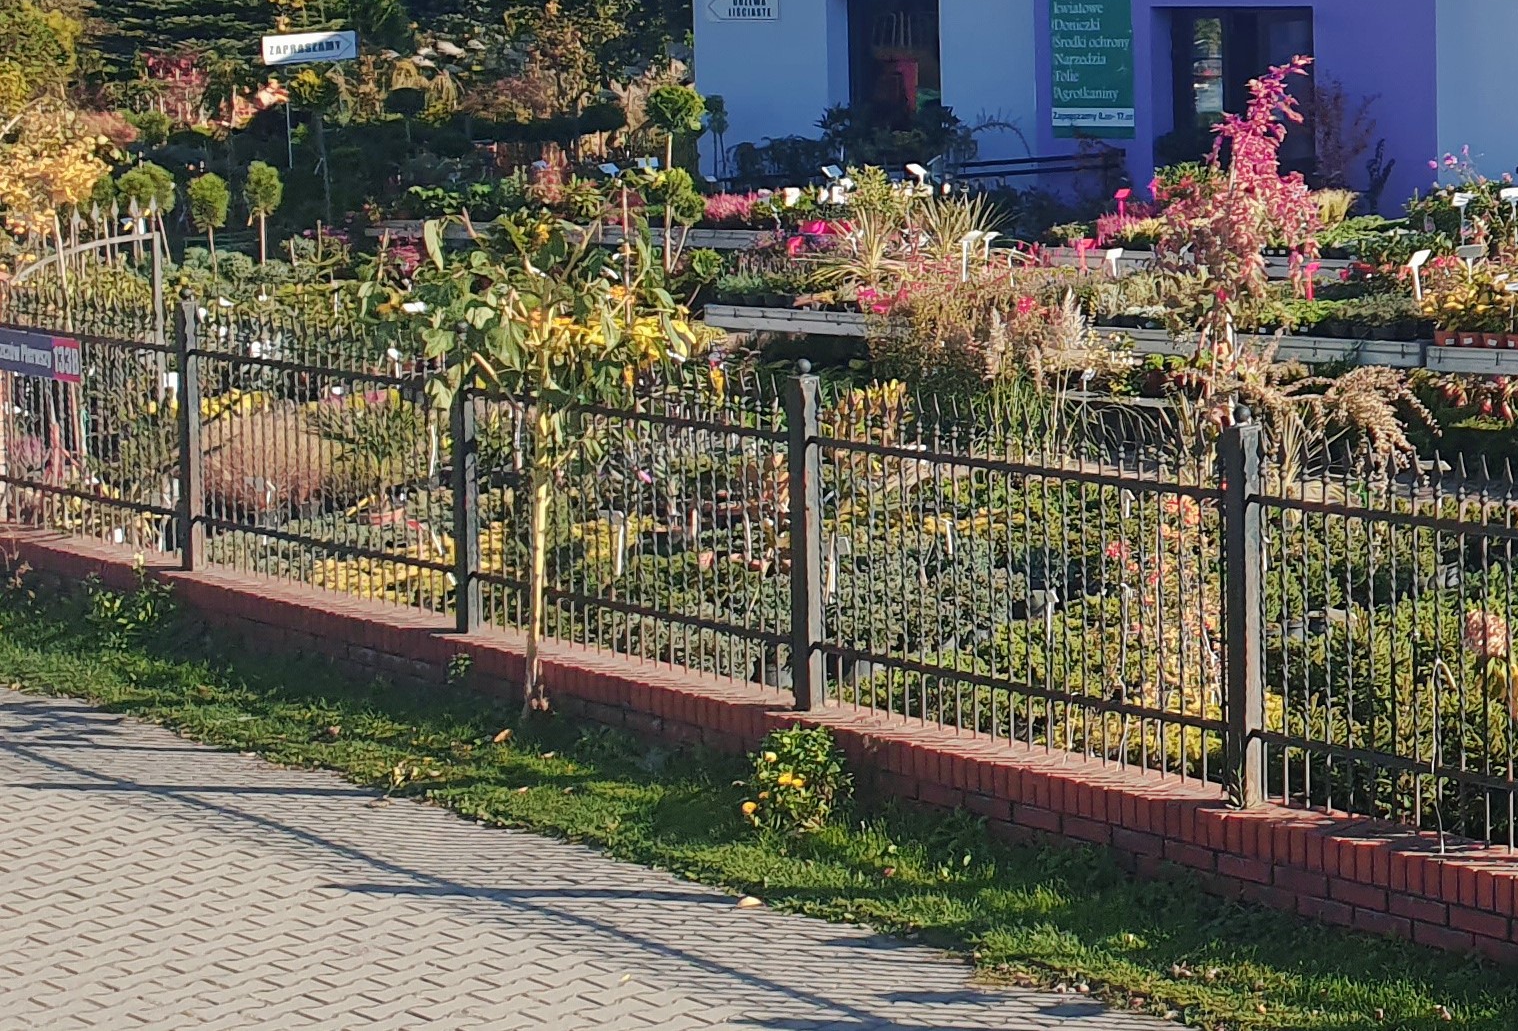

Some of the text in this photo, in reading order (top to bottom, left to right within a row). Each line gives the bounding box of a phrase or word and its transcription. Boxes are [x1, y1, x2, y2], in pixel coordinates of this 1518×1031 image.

[1052, 18, 1100, 31] Doniczki
[269, 41, 340, 55] ZAPRASZAMY
[1089, 36, 1130, 51] ochrony
[1053, 86, 1119, 102] Agrotkaniny
